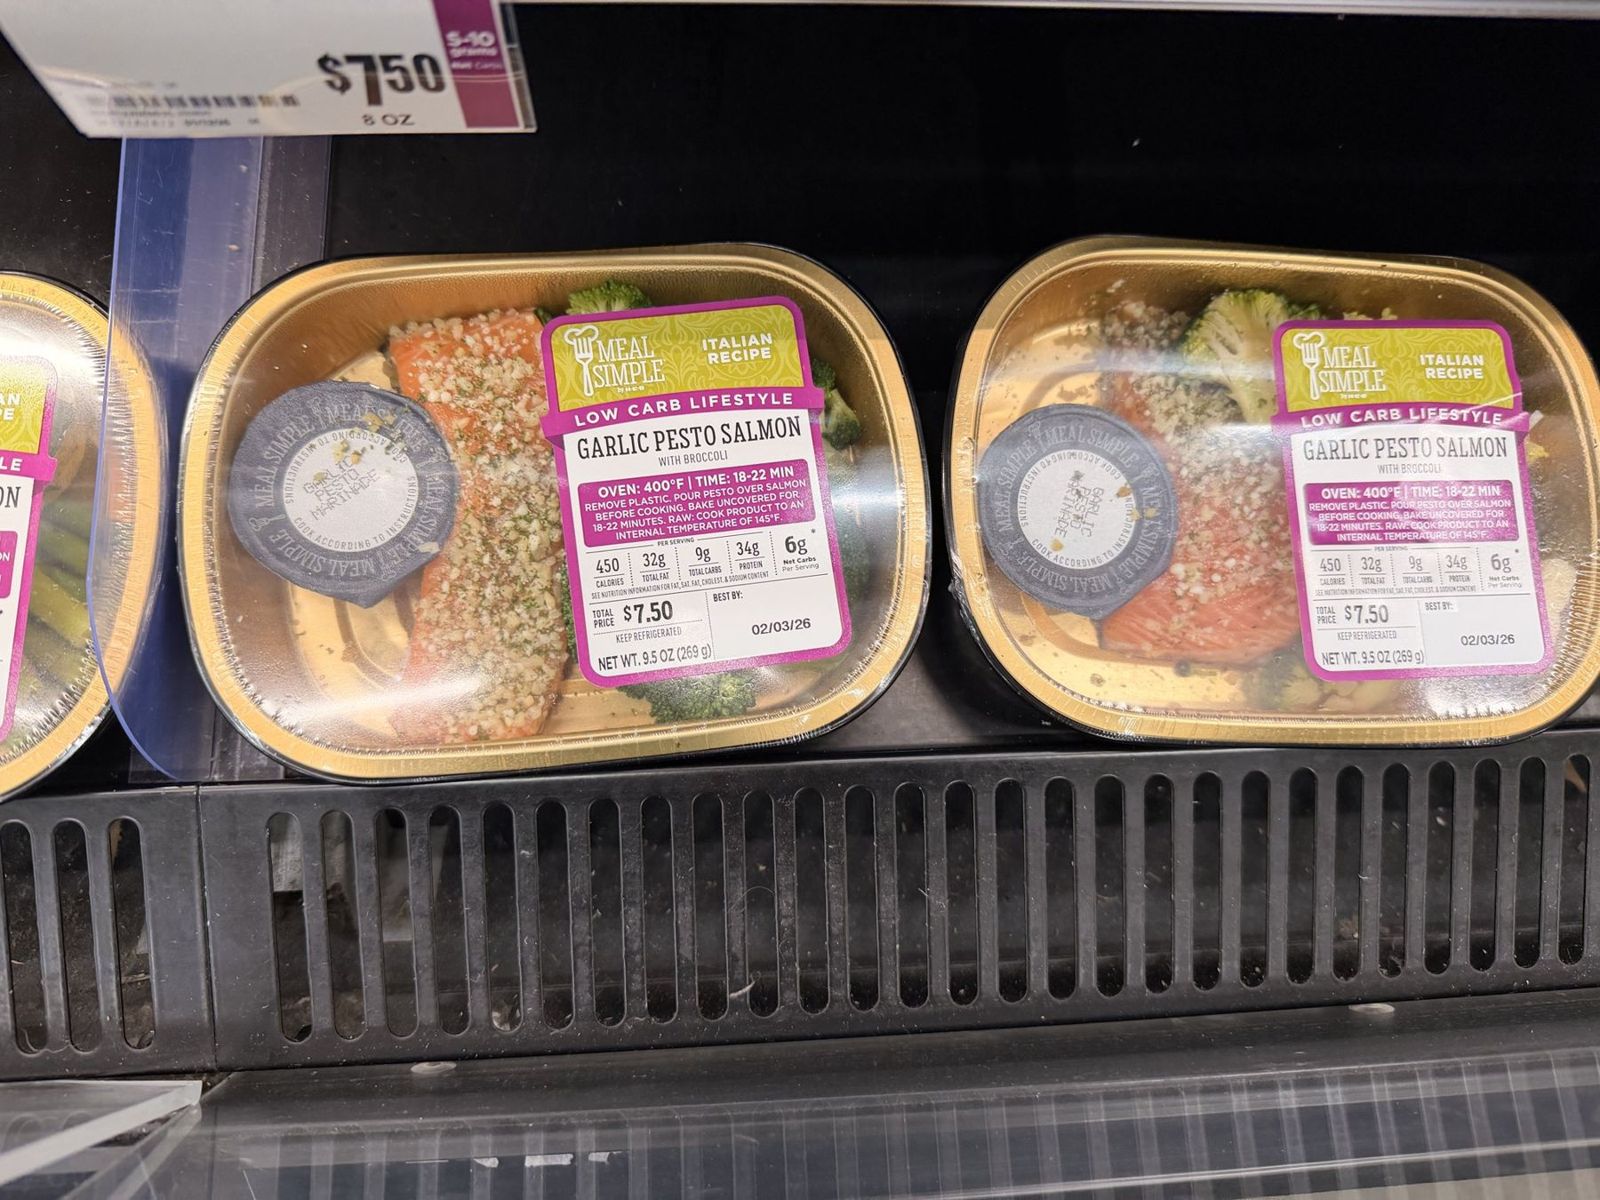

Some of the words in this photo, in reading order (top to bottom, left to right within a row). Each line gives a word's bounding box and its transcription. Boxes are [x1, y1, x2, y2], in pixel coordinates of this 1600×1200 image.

[362, 114, 375, 126] 8
[382, 114, 415, 126] OZ
[598, 336, 654, 362] MEAL
[702, 333, 772, 350] ITALIAN
[708, 348, 772, 364] RECIPE
[1322, 347, 1378, 369] MEAL
[1419, 354, 1484, 366] ITALIAN
[592, 359, 665, 388] SIMPLE
[1319, 369, 1386, 393] SIMPLE
[1426, 367, 1484, 380] RECIPE
[574, 408, 619, 426] LOW
[628, 399, 681, 418] CARB
[690, 393, 792, 409] LIFESTYLE
[1301, 412, 1342, 428] LOW
[1350, 408, 1401, 422] CARB
[1409, 408, 1503, 425] LIFESTYLE
[578, 431, 650, 460] GARLIC
[655, 425, 716, 452] PESTO
[721, 416, 801, 444] SALMON
[1304, 438, 1370, 460] GARLIC
[1374, 437, 1433, 459] PESTO
[1437, 436, 1508, 458] SALMON
[658, 456, 682, 467] WITH
[684, 450, 728, 465] BROCCOLI
[1377, 464, 1399, 474] WITH
[1401, 463, 1442, 474] BROCCOLI
[598, 484, 640, 498] OVEN:
[644, 478, 684, 492] 400°F
[695, 475, 730, 487] TIME:
[733, 469, 766, 482] 18-22
[770, 466, 794, 479] MIN
[585, 500, 627, 511] REMOVE
[629, 495, 672, 507] PLASTIC.
[674, 492, 701, 502] POUR
[704, 487, 734, 498] PESTO
[737, 484, 763, 494] OVER
[766, 480, 806, 491] SALMON
[1321, 487, 1360, 499] OVEN:
[1410, 486, 1442, 497] TIME:
[1446, 486, 1474, 496] 18-22
[1478, 486, 1500, 496] MIN
[294, 517, 314, 542] COOK
[315, 535, 372, 550] ACCORDING
[373, 532, 385, 544] TO
[386, 476, 416, 541] INSTRUCTIONS
[595, 509, 637, 521] BEFORE
[638, 504, 686, 516] COOKING.
[688, 500, 714, 511] BAKE
[717, 494, 776, 507] UNCOVERED
[780, 490, 799, 499] FOR
[1309, 502, 1348, 511] REMOVE
[593, 523, 618, 532] 18-22
[620, 517, 666, 529] MINUTES.
[668, 514, 694, 524] RAW:
[696, 510, 725, 520] COOK
[727, 505, 772, 517] PRODUCT
[775, 502, 788, 510] TO
[790, 501, 804, 509] AN
[616, 528, 665, 540] INTERNAL
[667, 519, 737, 534] TEMPERATURE
[740, 517, 752, 525] OF
[596, 558, 620, 574] 450
[643, 553, 666, 568] 32g
[696, 547, 711, 562] 9g
[736, 541, 760, 556] 34g
[1031, 539, 1052, 559] COOK
[1053, 554, 1103, 568] ACCORDING
[689, 568, 704, 576] TOTAL
[705, 566, 721, 574] CARBS
[739, 561, 763, 570] PROTEIN
[1320, 558, 1341, 572] 450
[1361, 557, 1382, 572] 32g
[1409, 556, 1422, 571] 9g
[1446, 555, 1468, 570] 34g
[596, 578, 624, 588] CALORIES
[601, 589, 627, 598] NUTRITION
[628, 585, 660, 596] INFORMATION
[729, 573, 747, 582] SODIUM
[748, 571, 769, 580] CONTENT
[642, 574, 659, 582] TOTAL
[660, 572, 669, 580] FAT
[713, 591, 731, 602] BEST
[732, 590, 743, 600] BY:
[592, 608, 614, 618] TOTAL
[623, 601, 673, 623] $7.50
[1344, 604, 1388, 624] $7.50
[1425, 602, 1441, 610] BEST
[594, 617, 615, 628] PRICE
[752, 617, 811, 636] 02/03/26
[1317, 616, 1336, 624] PRICE
[616, 633, 632, 643] KEEP
[634, 626, 681, 641] REFRIGERATED
[1337, 632, 1352, 640] KEEP
[1354, 630, 1397, 640] REFRIGERATED
[1460, 634, 1515, 646] 02/03/26
[598, 655, 618, 671] NET
[620, 652, 640, 668] WT.
[643, 650, 657, 665] 9.5
[660, 648, 674, 662] OZ
[677, 644, 698, 662] (269
[701, 643, 712, 659] g)
[1321, 652, 1339, 665] NET
[1341, 651, 1360, 665] WT.
[1362, 651, 1375, 664] 9.5
[1377, 650, 1391, 663] OZ
[1393, 650, 1412, 664] (269
[1415, 650, 1424, 664] g)
